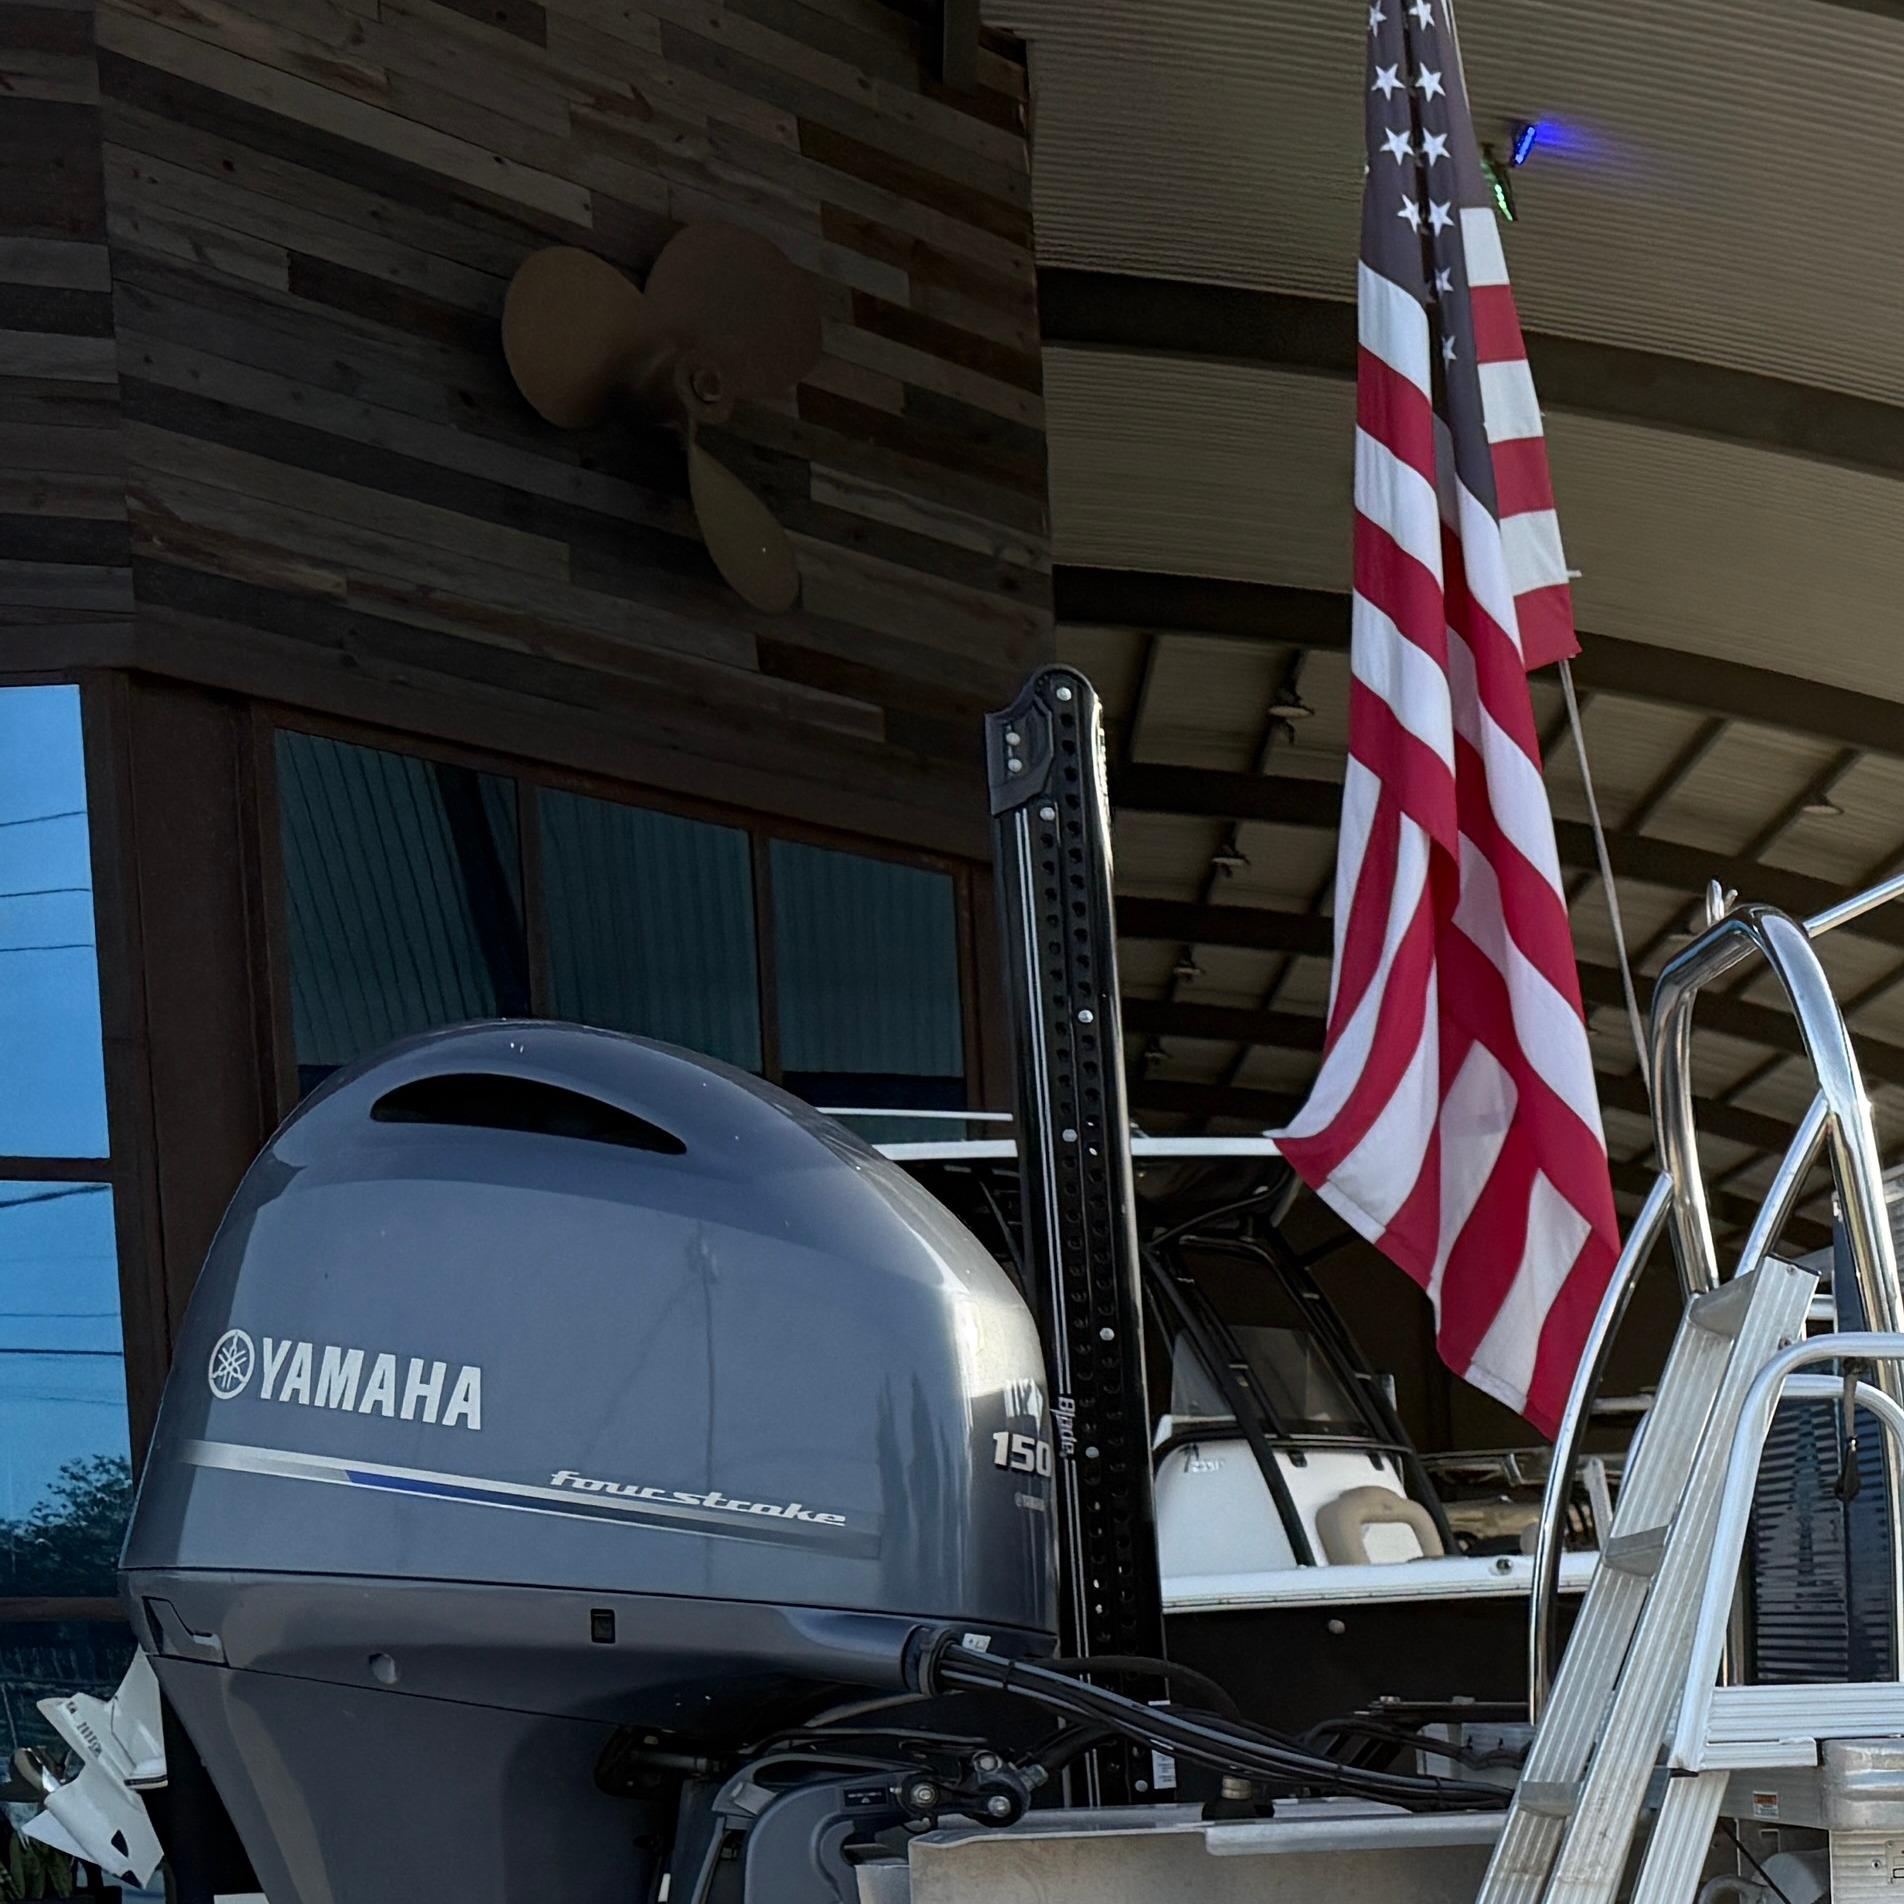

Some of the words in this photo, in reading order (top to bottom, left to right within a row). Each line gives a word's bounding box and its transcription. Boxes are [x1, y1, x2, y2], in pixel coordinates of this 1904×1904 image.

[260, 1336, 483, 1432] YAMAHA
[993, 1431, 1051, 1478] 150
[1050, 1396, 1078, 1455] Blade
[550, 1470, 847, 1527] fourstroke
